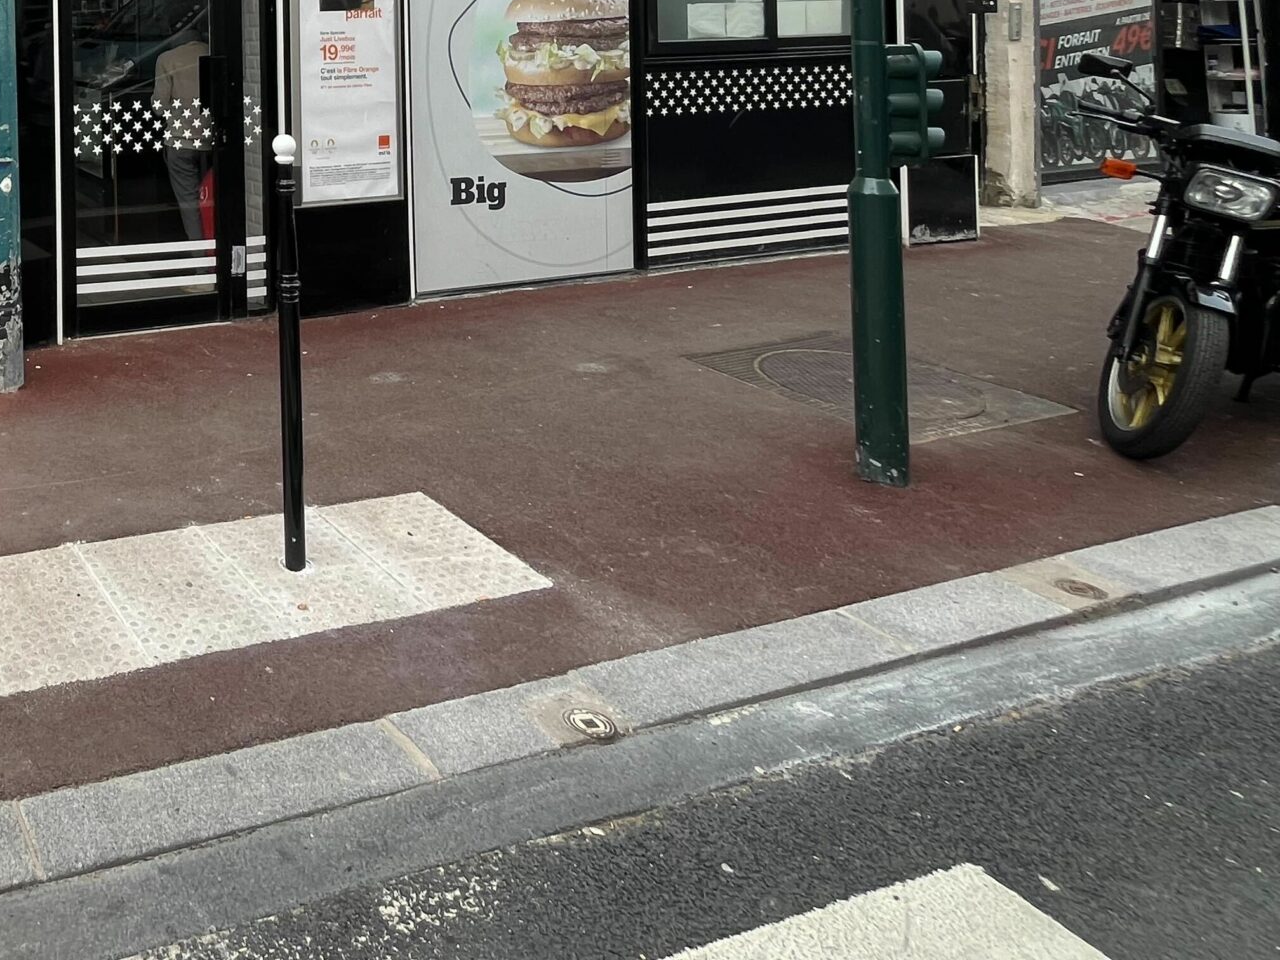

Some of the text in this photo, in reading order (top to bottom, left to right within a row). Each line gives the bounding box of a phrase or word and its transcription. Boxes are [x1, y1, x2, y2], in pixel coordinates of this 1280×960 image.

[346, 7, 382, 21] parfait
[1057, 29, 1102, 49] FORFAIT
[320, 44, 338, 61] 19
[450, 176, 506, 210] Big
